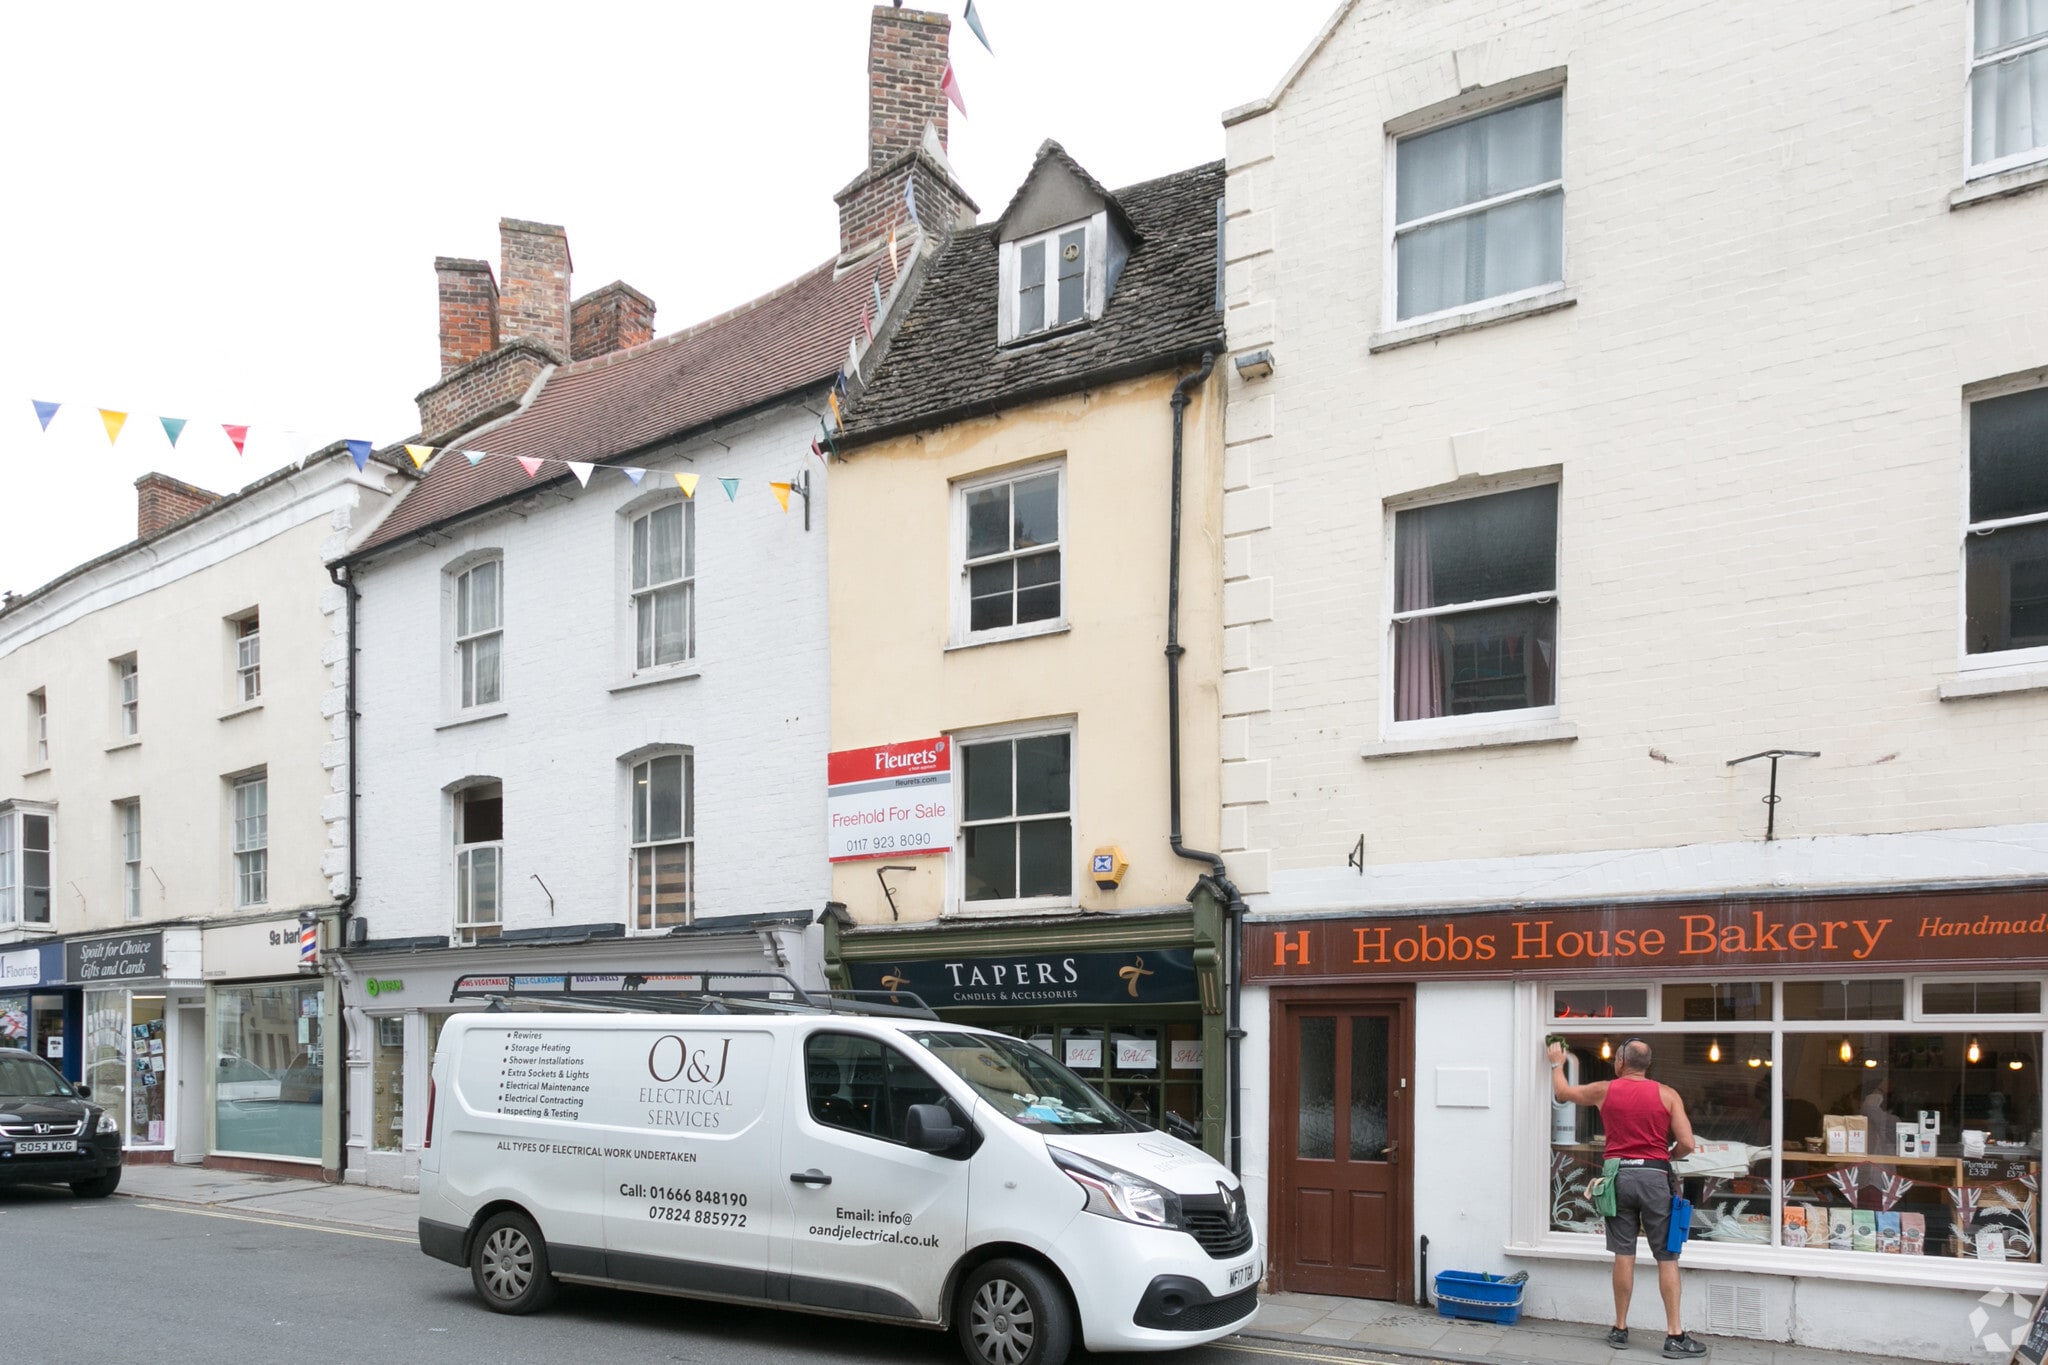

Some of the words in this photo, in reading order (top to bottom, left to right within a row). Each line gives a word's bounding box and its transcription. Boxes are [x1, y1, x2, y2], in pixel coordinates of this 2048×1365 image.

[875, 749, 937, 770] Fleurets
[895, 776, 937, 787] fleurets.com
[832, 808, 885, 828] Freehold
[889, 806, 911, 822] For
[915, 802, 946, 819] Sale
[846, 838, 868, 852] 0117
[873, 835, 895, 849] 923
[900, 832, 931, 847] 8090
[269, 930, 281, 945] 9a
[1353, 923, 1496, 964] Hobbs
[1511, 920, 1666, 959] House
[1678, 911, 1893, 960] Bakery
[80, 943, 104, 963] Spoilt
[103, 942, 119, 961] for
[119, 940, 152, 956] Choice
[6, 965, 38, 979] Flooring
[81, 960, 100, 979] Gifts
[101, 960, 119, 976] and
[119, 958, 147, 974] Cards
[944, 958, 1078, 987] TAPERS
[1000, 991, 1008, 1000] &
[512, 1030, 542, 1040] Rewires
[510, 1043, 540, 1054] Storage
[541, 1043, 571, 1054] Heating
[1069, 1048, 1097, 1062] SALE
[1120, 1049, 1152, 1063] SALE
[508, 1055, 537, 1065] Shower
[538, 1056, 584, 1065] Installations
[648, 1035, 733, 1090] O&J
[507, 1068, 526, 1077] Extra
[528, 1068, 557, 1078] Sockets
[558, 1070, 564, 1079] &
[566, 1070, 590, 1081] Lights
[506, 1081, 540, 1090] Electrical
[540, 1082, 590, 1092] Maintenance
[504, 1093, 538, 1103] Electrical
[539, 1095, 584, 1107] Contracting
[639, 1087, 733, 1106] ELECTRICAL
[503, 1106, 542, 1118] Inspecting
[543, 1108, 549, 1117] &
[551, 1108, 579, 1120] Testing
[647, 1109, 720, 1128] SERVICES
[52, 1141, 72, 1151] WXG
[497, 1141, 512, 1151] ALL
[512, 1142, 537, 1152] TYPES
[538, 1143, 551, 1153] OF
[552, 1144, 602, 1157] ELECTRICAL
[603, 1147, 632, 1159] WORK
[634, 1150, 697, 1163] UNDERTAKEN
[620, 1183, 647, 1198] Call:
[650, 1186, 692, 1202] 01666
[695, 1190, 748, 1207] 848190
[649, 1206, 691, 1222] 07824
[694, 1209, 747, 1228] 885972
[836, 1207, 875, 1222] Email:
[878, 1210, 913, 1226] info@
[808, 1224, 940, 1248] oandjelectrical.co.uk
